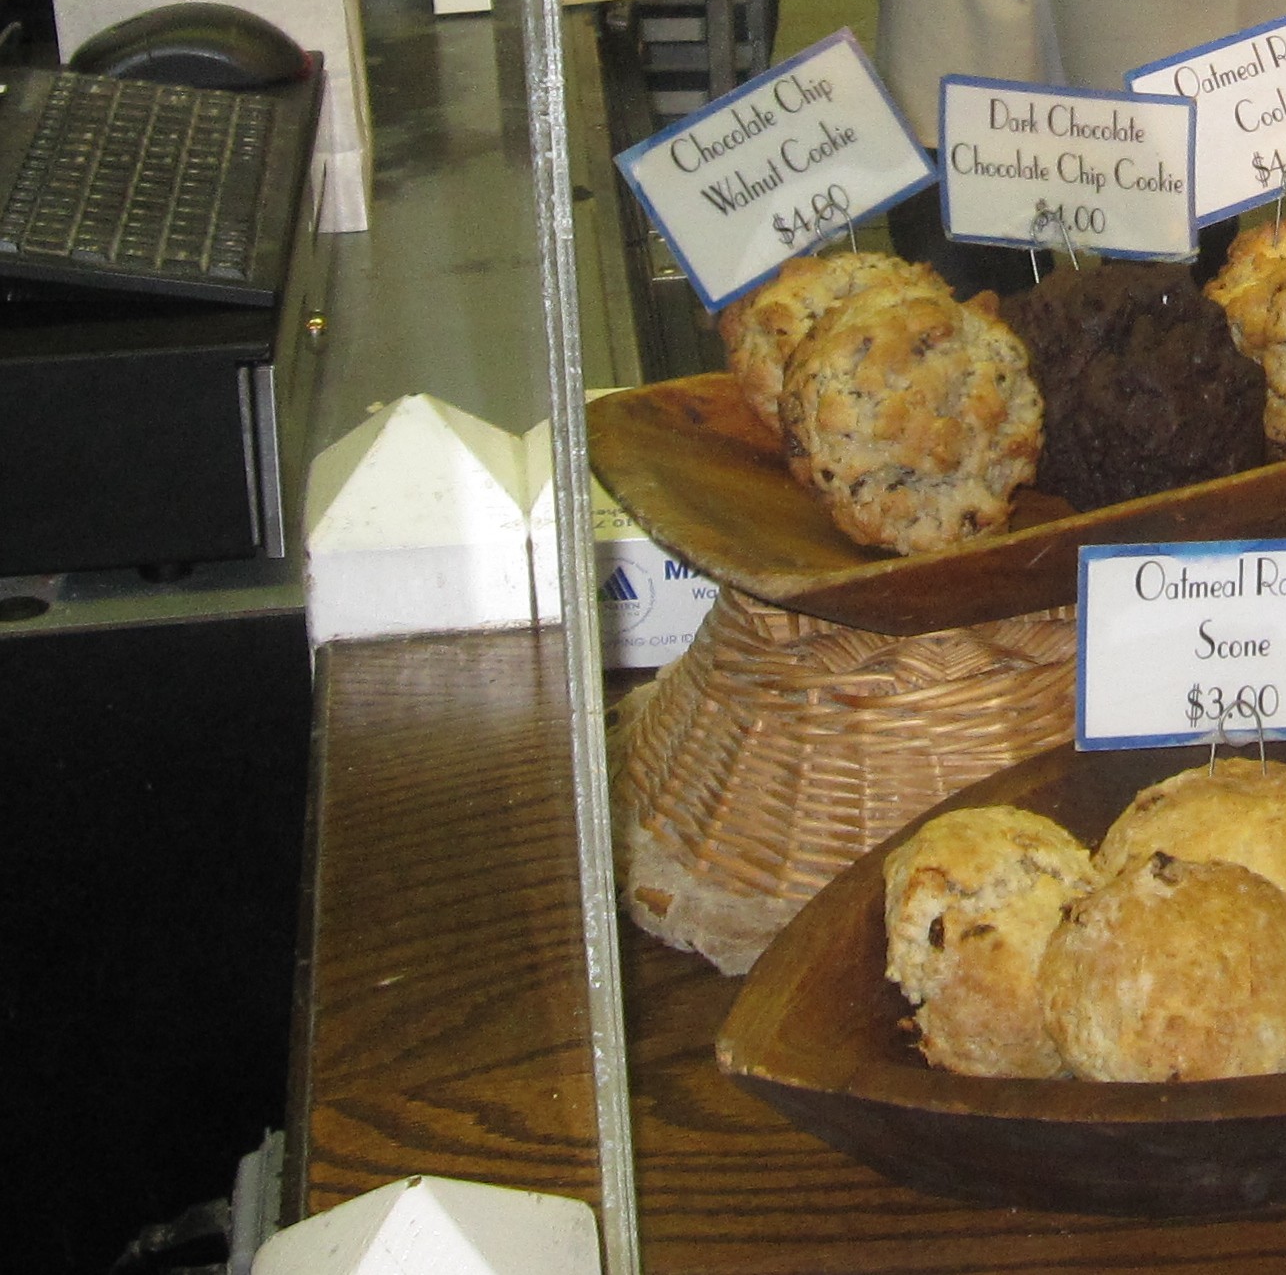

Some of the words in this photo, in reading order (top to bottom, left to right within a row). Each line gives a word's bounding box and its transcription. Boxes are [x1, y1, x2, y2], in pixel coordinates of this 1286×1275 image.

[1173, 49, 1265, 99] Oatmeal
[670, 103, 777, 174] Chocolate
[773, 73, 835, 120] Chip
[989, 98, 1039, 135] Dark
[1047, 104, 1146, 144] Chocolate
[700, 162, 785, 217] Walnut
[780, 123, 858, 173] Cookie
[951, 143, 1051, 182] Chocolate
[1057, 149, 1106, 193] Chip
[1114, 156, 1184, 195] Cookie
[773, 184, 850, 249] $400
[1135, 558, 1243, 601] Oatmeal
[1195, 619, 1271, 659] Scone
